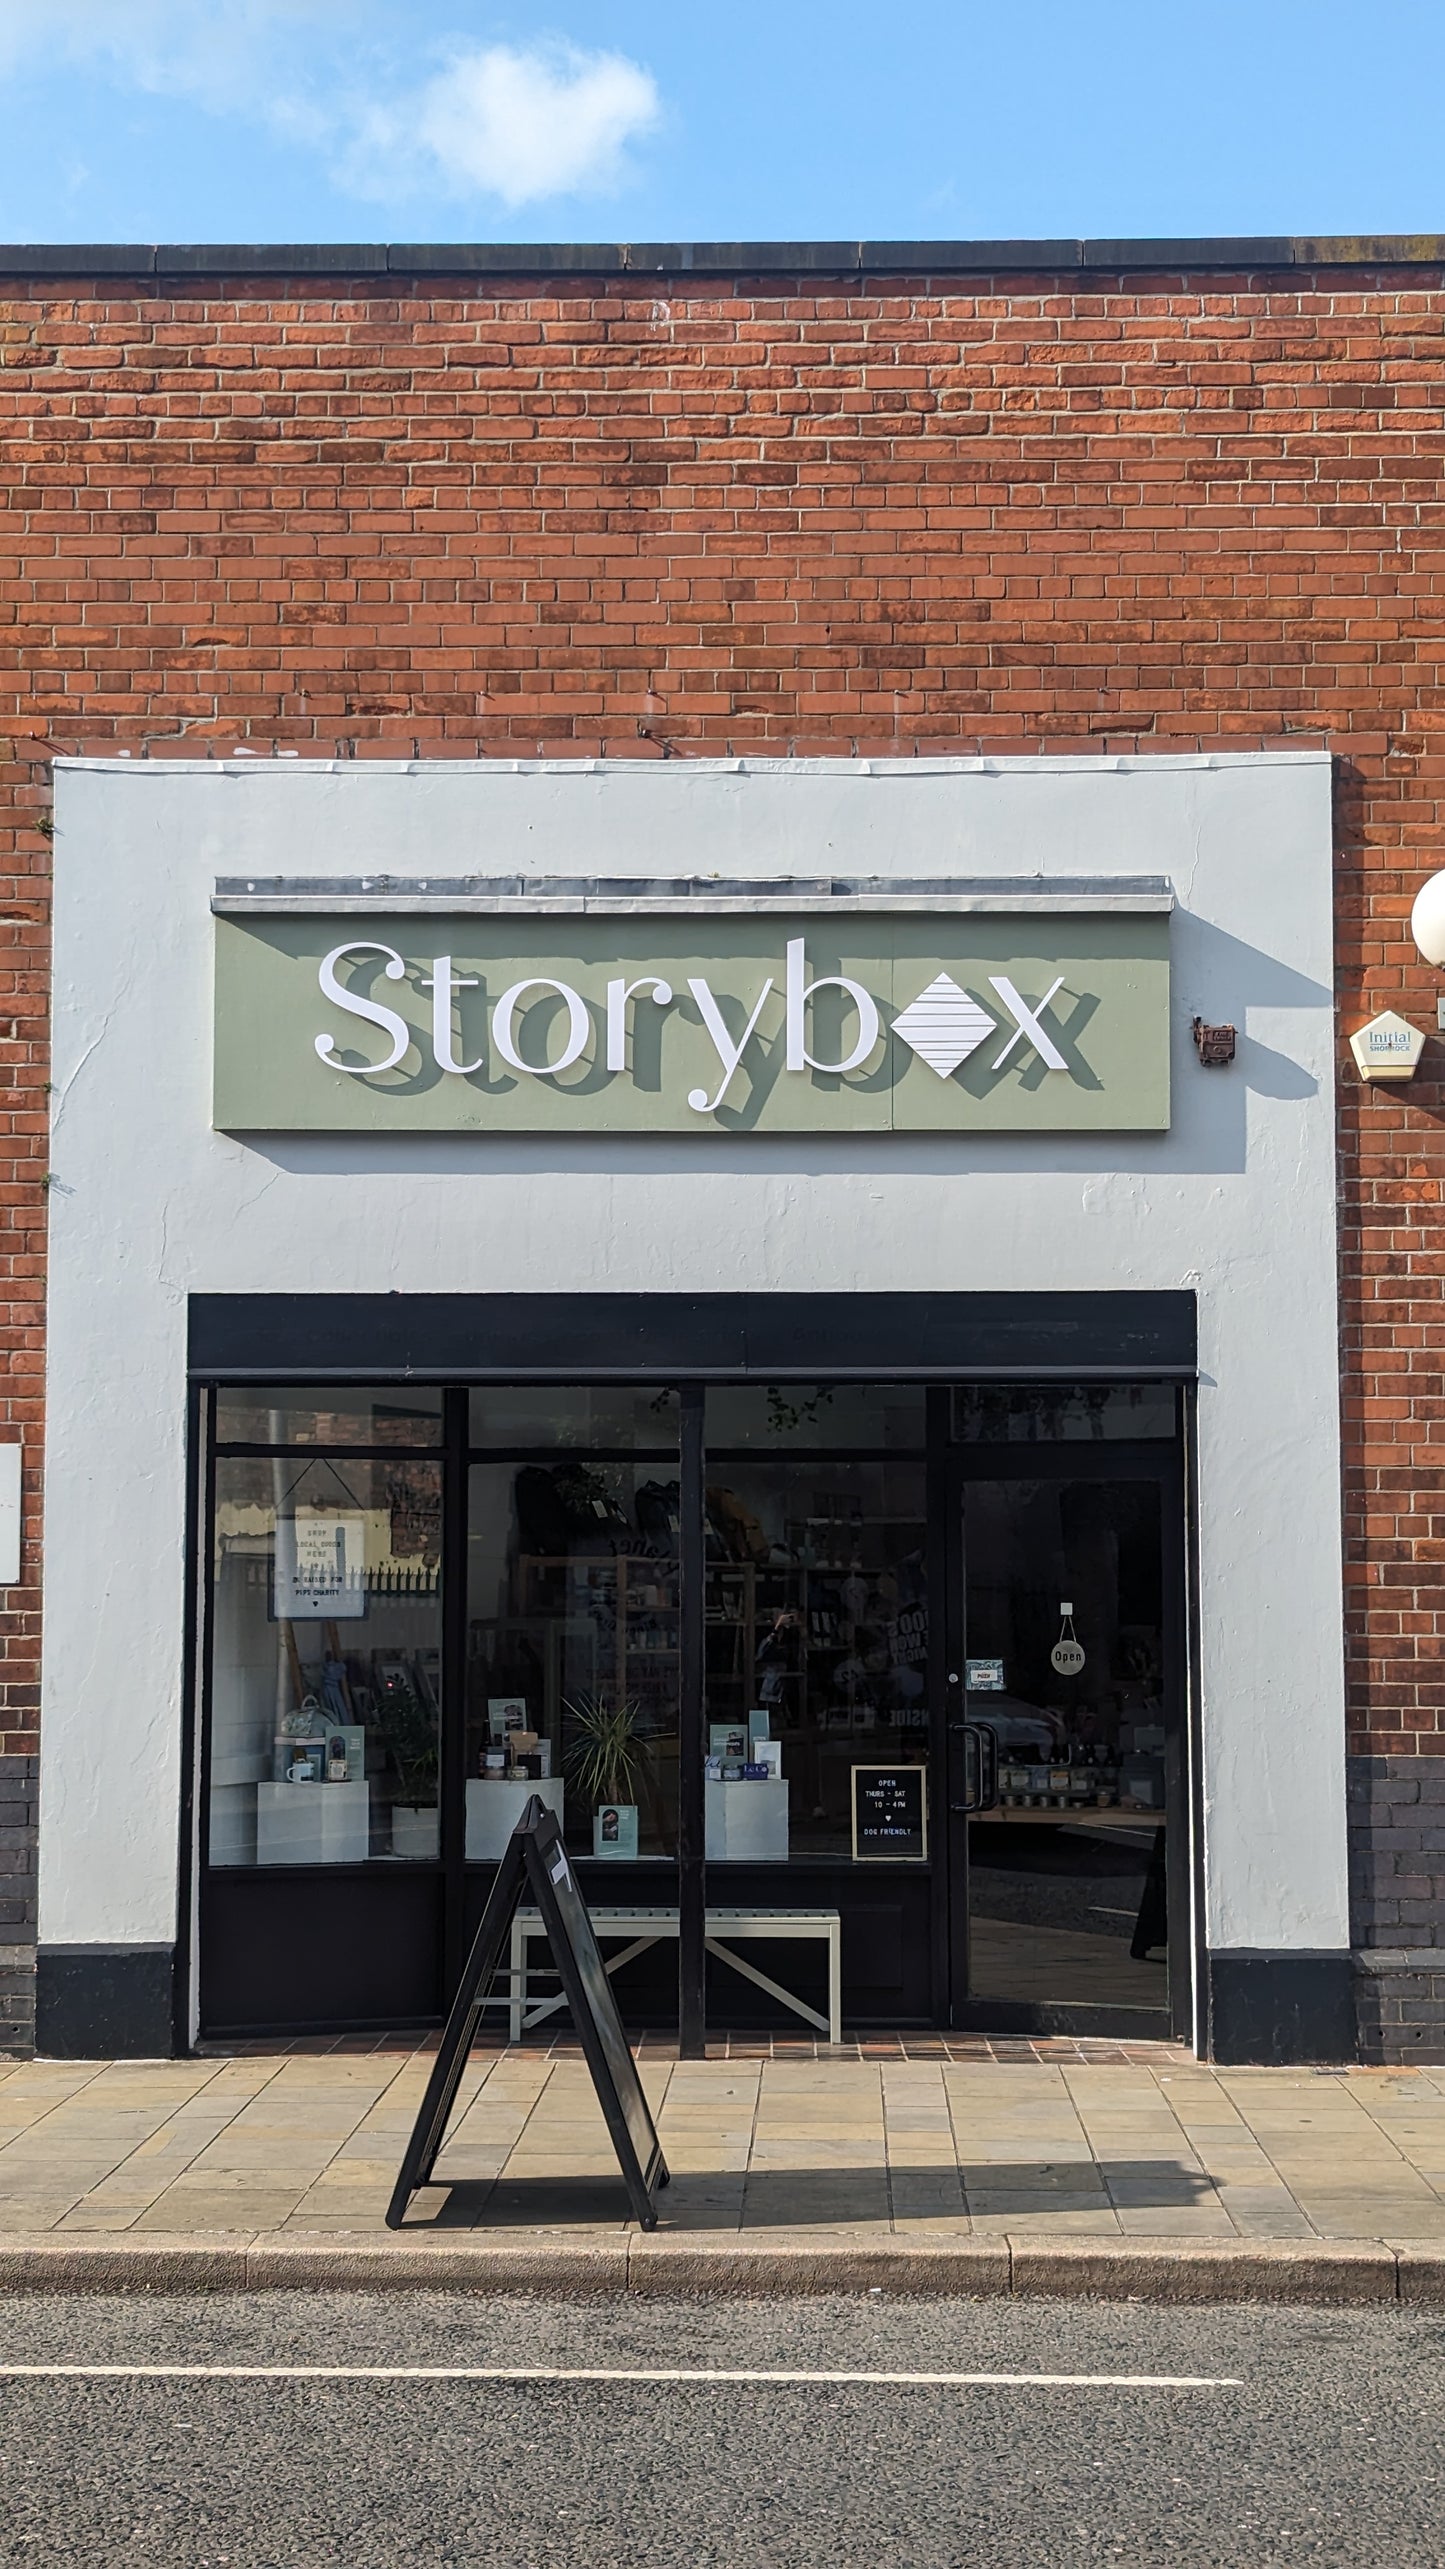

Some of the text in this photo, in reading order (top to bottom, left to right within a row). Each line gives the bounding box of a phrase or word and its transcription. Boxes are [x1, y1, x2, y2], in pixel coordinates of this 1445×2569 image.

[1369, 1031, 1411, 1043] Initial
[1055, 1650, 1082, 1664] Open
[878, 1779, 897, 1787] OPEN
[880, 1828, 912, 1836] FRIENDLY
